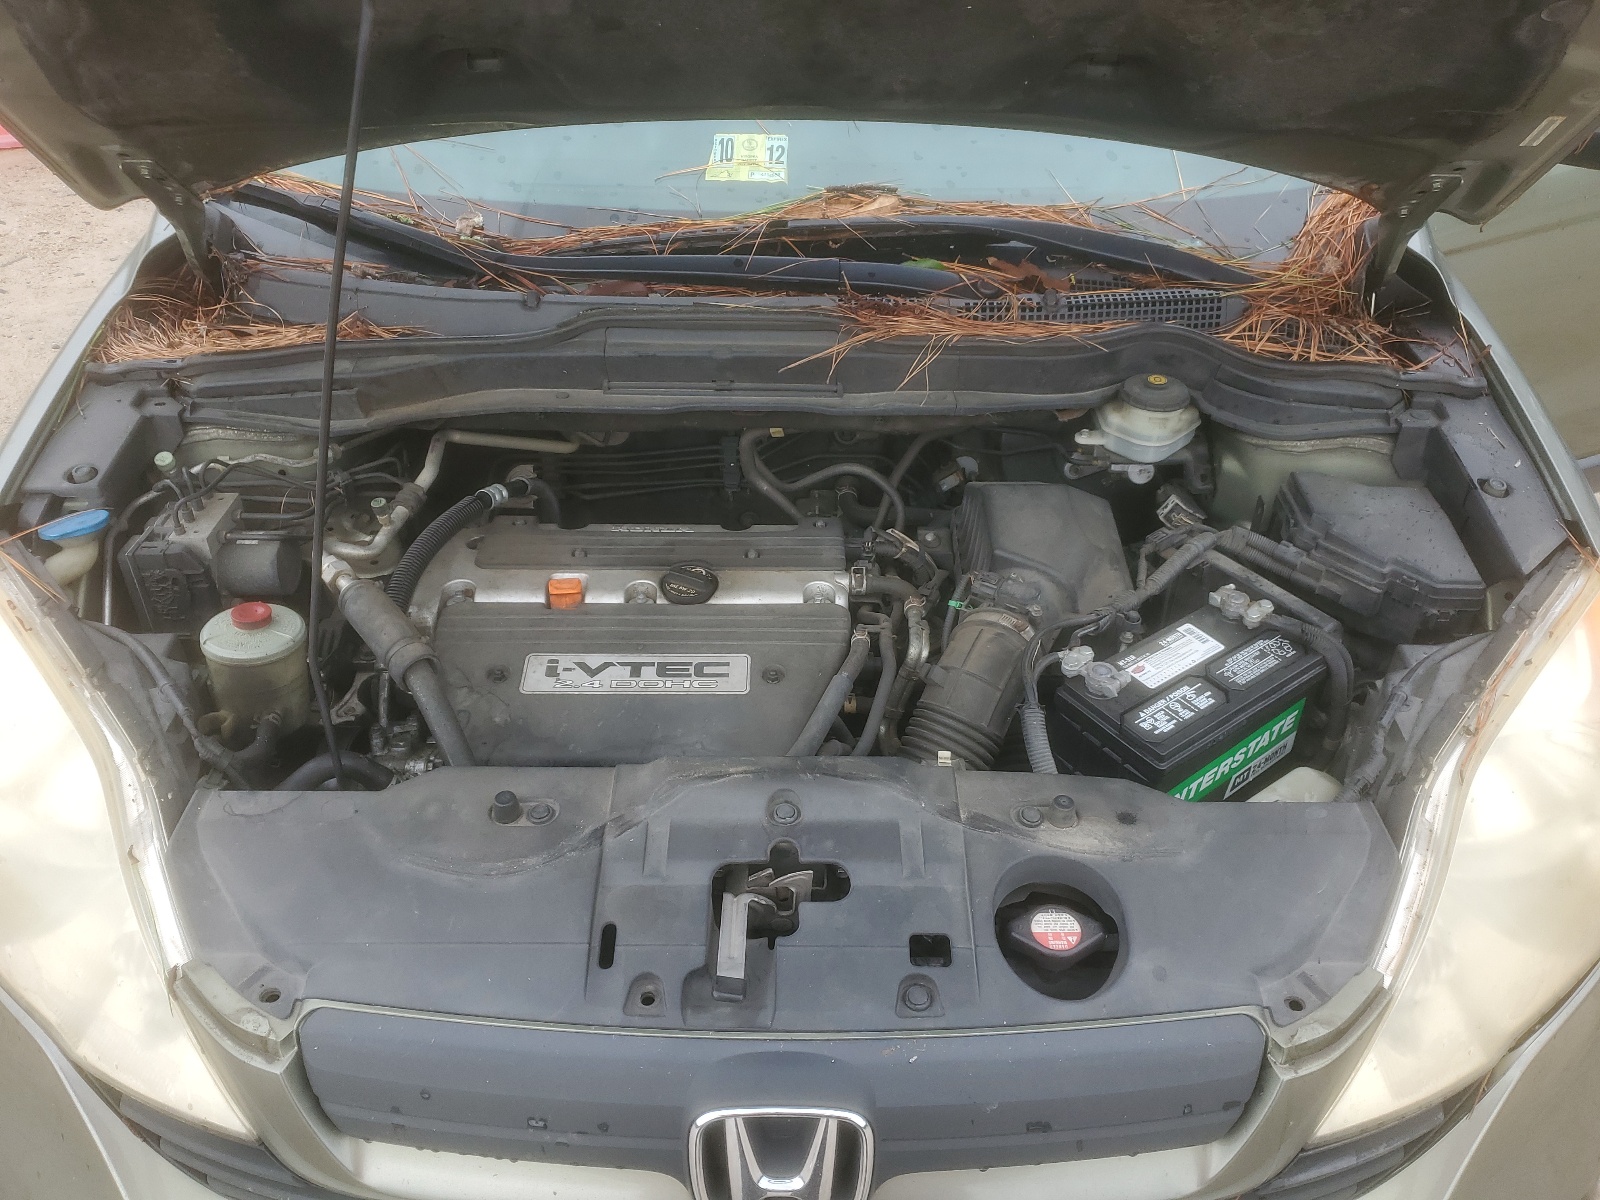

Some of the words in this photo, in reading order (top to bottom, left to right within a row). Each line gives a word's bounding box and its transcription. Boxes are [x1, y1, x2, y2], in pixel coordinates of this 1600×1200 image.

[719, 137, 734, 163] 10
[767, 144, 785, 165] 12
[545, 658, 730, 679] i-VTEC
[553, 678, 603, 689] 2.4
[609, 679, 719, 689] DOHC
[1174, 709, 1299, 801] NTERSTATE
[1234, 770, 1250, 786] MT
